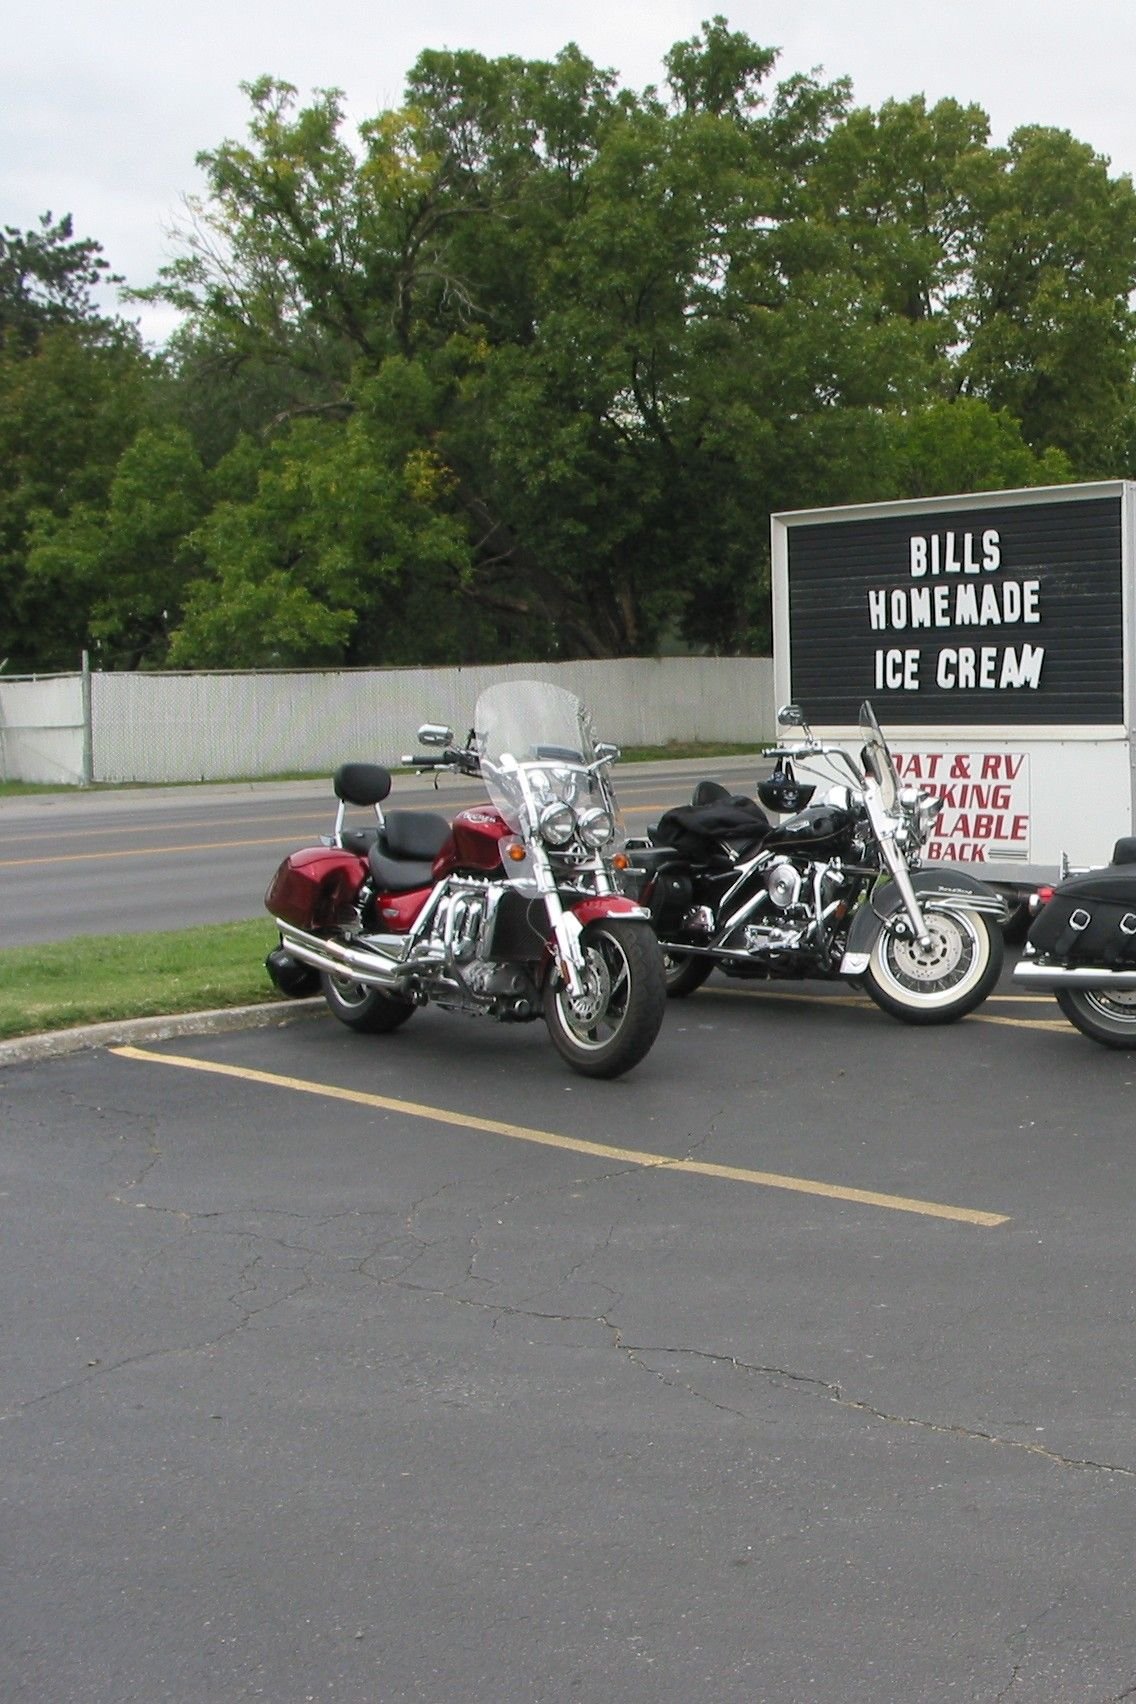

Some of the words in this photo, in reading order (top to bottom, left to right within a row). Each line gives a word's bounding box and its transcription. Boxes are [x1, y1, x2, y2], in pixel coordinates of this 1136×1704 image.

[910, 529, 1000, 577] BILLS
[868, 580, 1041, 630] HOMEMADE
[875, 649, 921, 690] ICE
[936, 643, 1045, 690] CREAM
[892, 753, 944, 779] OAT
[949, 754, 971, 780] &
[980, 754, 1026, 780] RV
[927, 841, 986, 862] BACK
